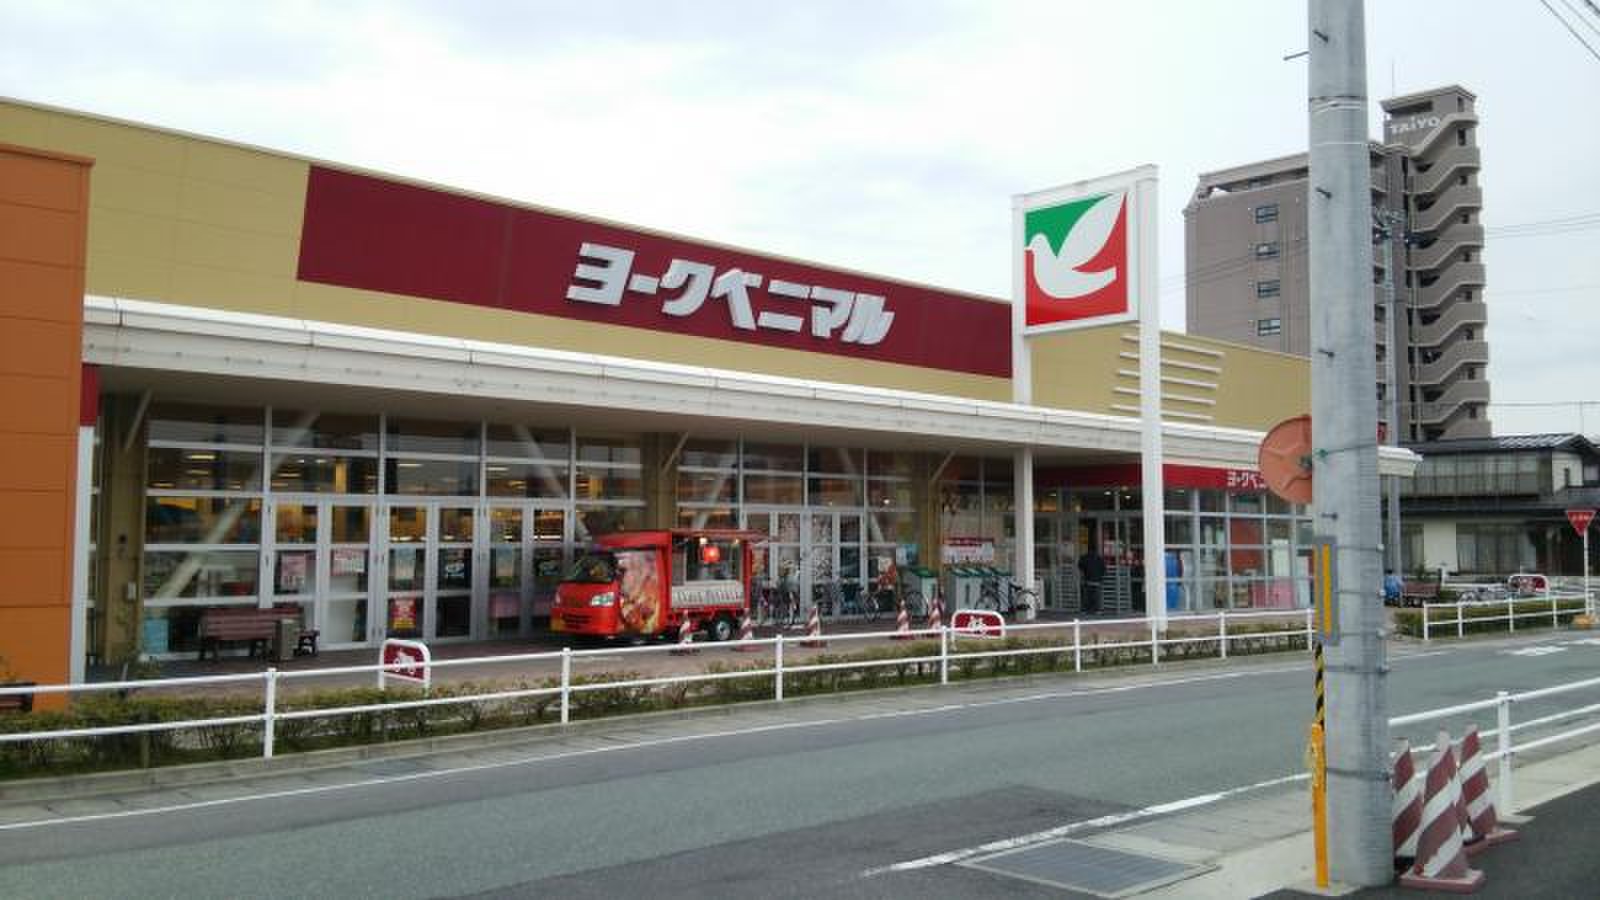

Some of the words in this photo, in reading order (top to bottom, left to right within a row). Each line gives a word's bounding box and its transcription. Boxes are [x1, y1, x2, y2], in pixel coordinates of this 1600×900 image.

[566, 242, 895, 344] ヨークベニマル
